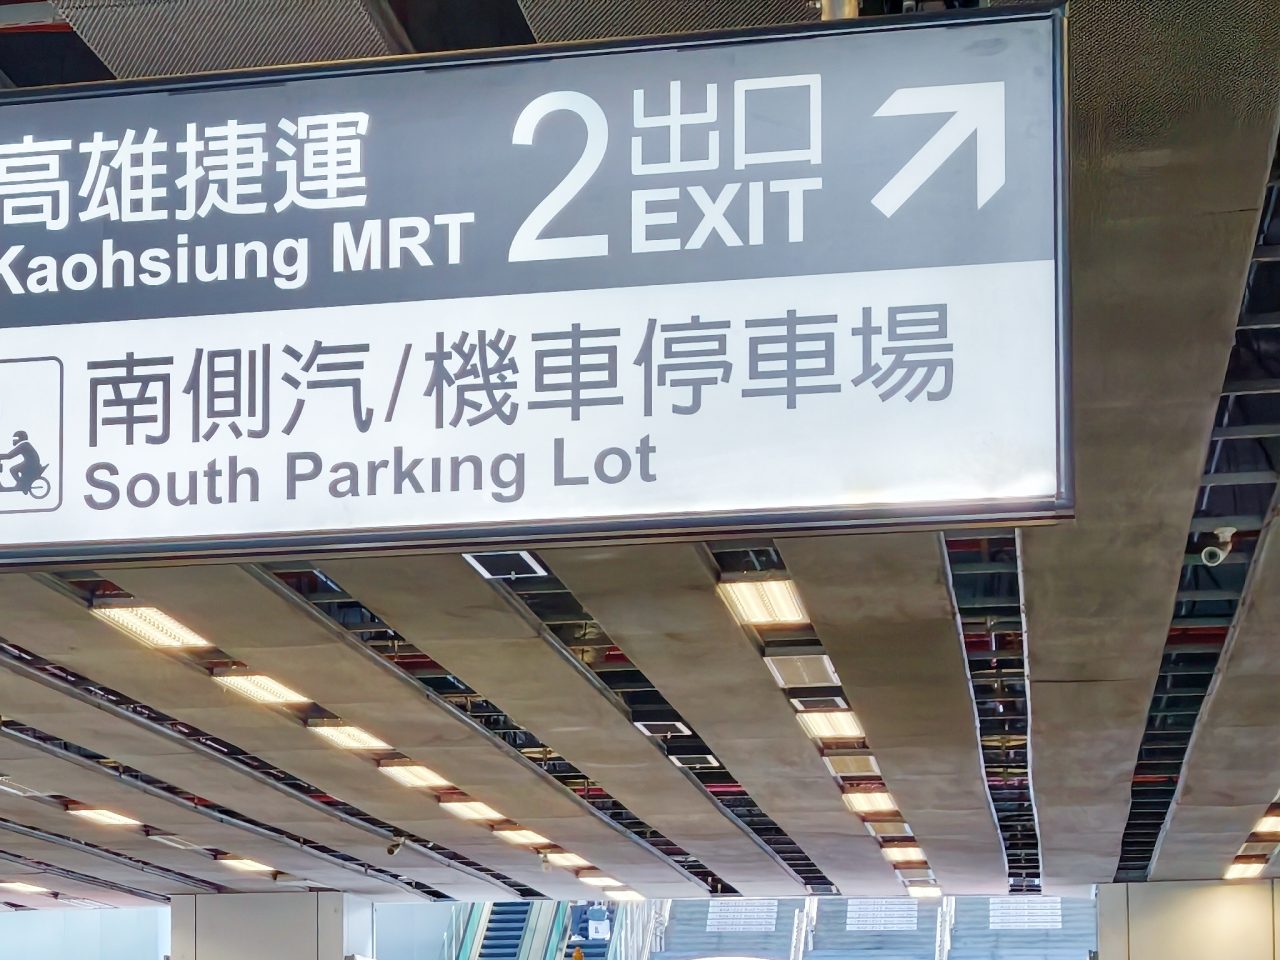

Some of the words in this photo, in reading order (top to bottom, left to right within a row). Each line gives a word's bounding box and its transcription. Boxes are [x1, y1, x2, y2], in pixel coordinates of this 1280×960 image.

[631, 73, 822, 177] 出口
[508, 91, 609, 263] 2
[631, 177, 822, 253] EXIT
[332, 211, 474, 272] MRT
[82, 456, 259, 512] South
[286, 445, 526, 504] Parking
[553, 434, 657, 487] Lot
